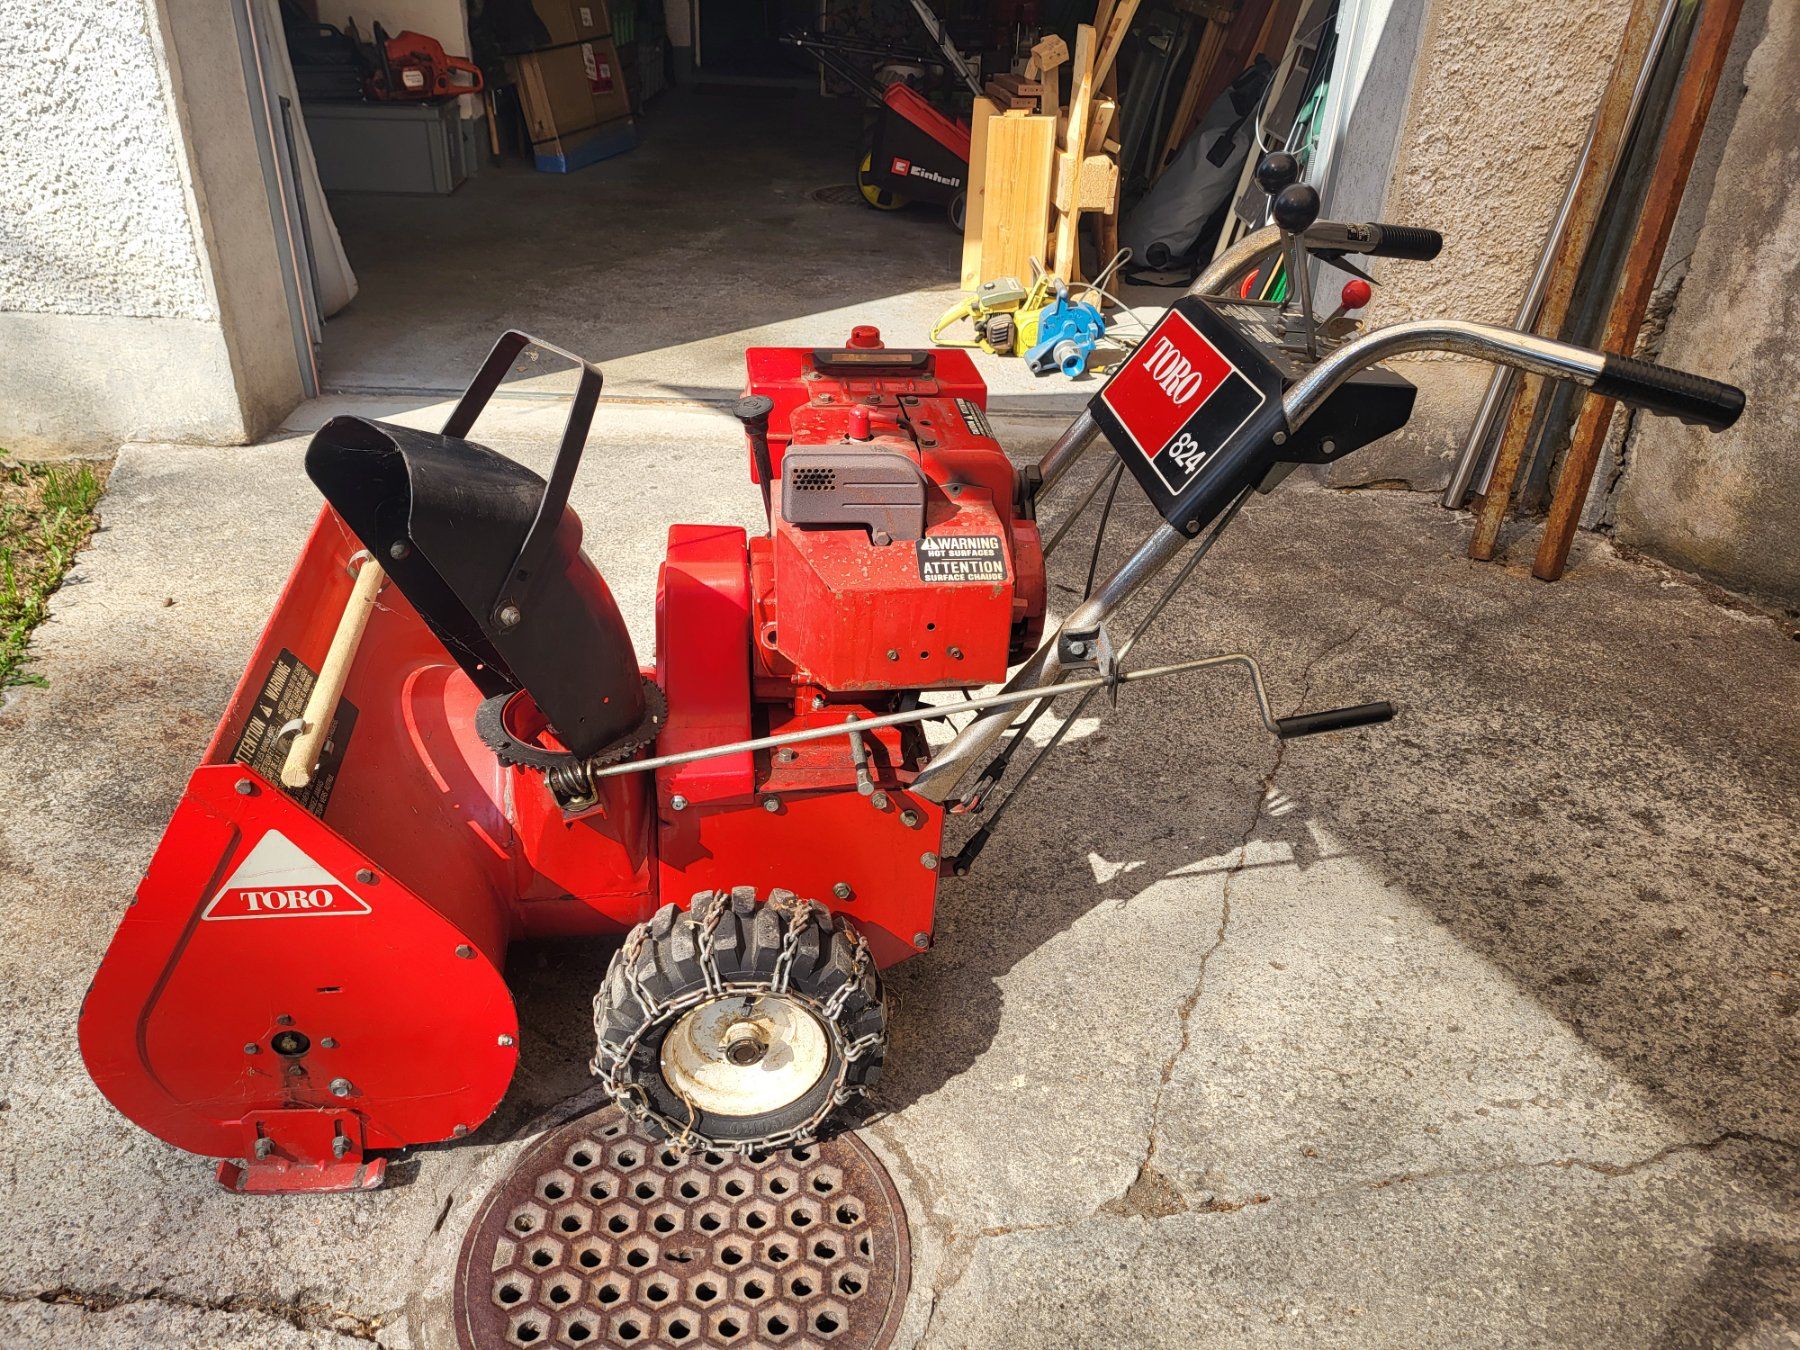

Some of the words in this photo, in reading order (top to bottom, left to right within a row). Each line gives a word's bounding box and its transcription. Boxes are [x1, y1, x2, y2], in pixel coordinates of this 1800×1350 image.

[910, 165, 960, 188] Einhell
[1143, 336, 1203, 405] TORO
[1168, 432, 1207, 475] 824
[938, 537, 999, 550] WARNING
[948, 549, 994, 557] SURFACES
[924, 561, 1003, 574] ATTENTION
[264, 661, 291, 702] WARNING
[240, 889, 334, 911] TORO
